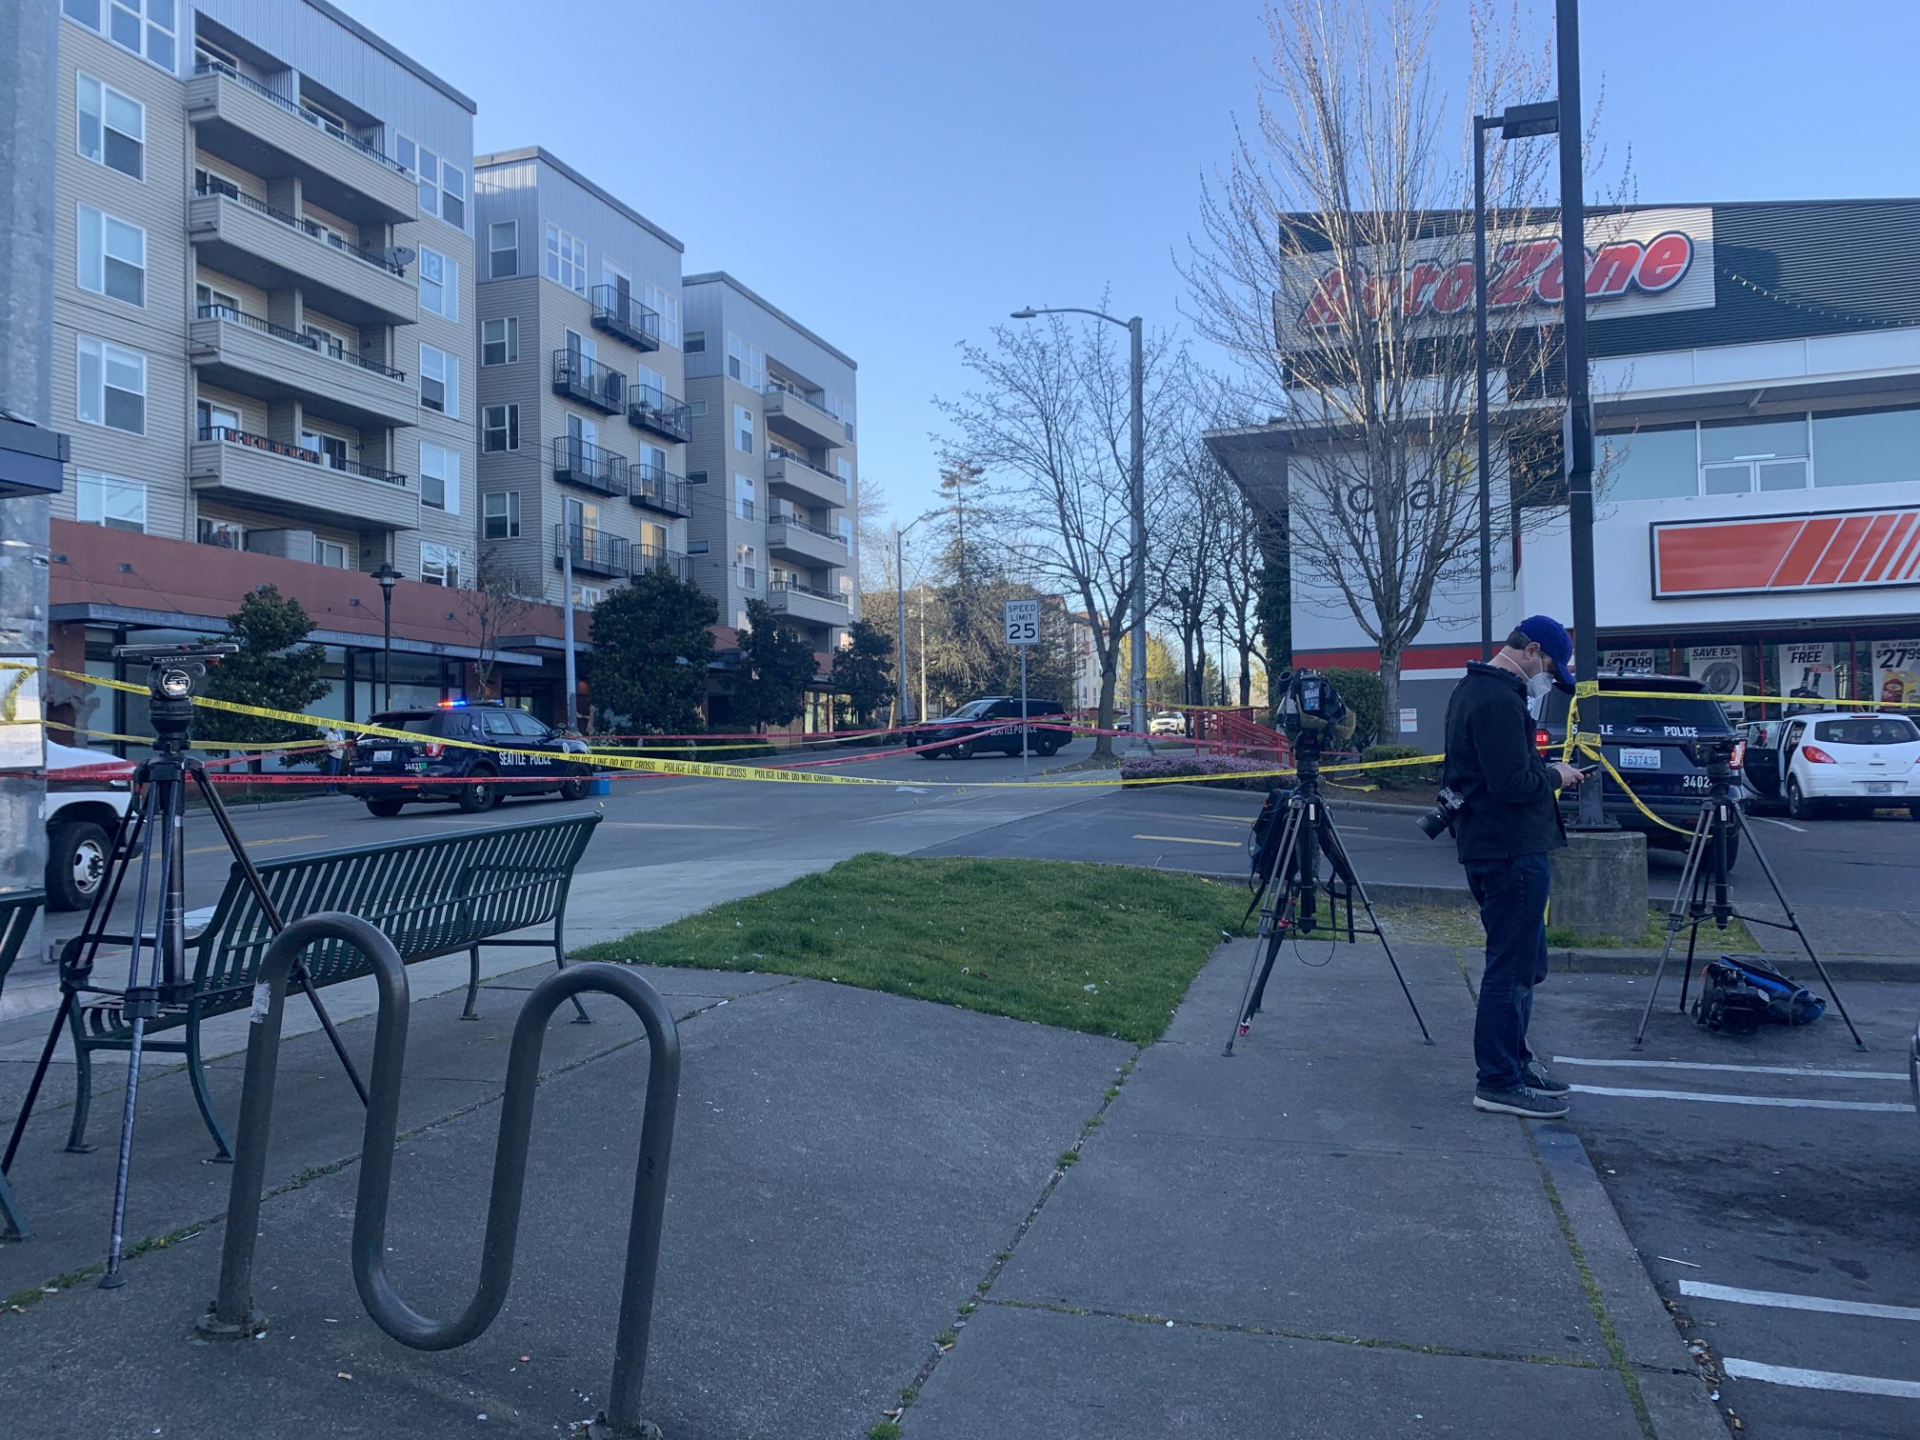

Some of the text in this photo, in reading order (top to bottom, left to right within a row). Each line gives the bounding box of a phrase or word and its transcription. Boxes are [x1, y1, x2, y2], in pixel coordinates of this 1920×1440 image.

[1007, 604, 1036, 612] SPEED
[1010, 613, 1032, 621] LIMIT
[1009, 622, 1036, 639] 25
[1692, 648, 1718, 657] SAVE
[1791, 651, 1822, 663] FREE
[1014, 724, 1038, 734] POICE
[1663, 726, 1699, 737] POLICE
[499, 752, 526, 765] SEATTLE
[529, 754, 552, 765] POLICE
[620, 760, 633, 768] NOT
[634, 761, 656, 771] CROSS
[664, 762, 685, 774] POLICE
[687, 764, 701, 774] LINE
[702, 765, 712, 775] DO
[712, 766, 725, 777] NOT
[726, 767, 747, 778] CROSS
[754, 769, 775, 779] POLICE
[776, 771, 789, 780] LINE
[791, 772, 800, 781] DO
[801, 773, 813, 782] NOT
[1683, 775, 1711, 788] 3402
